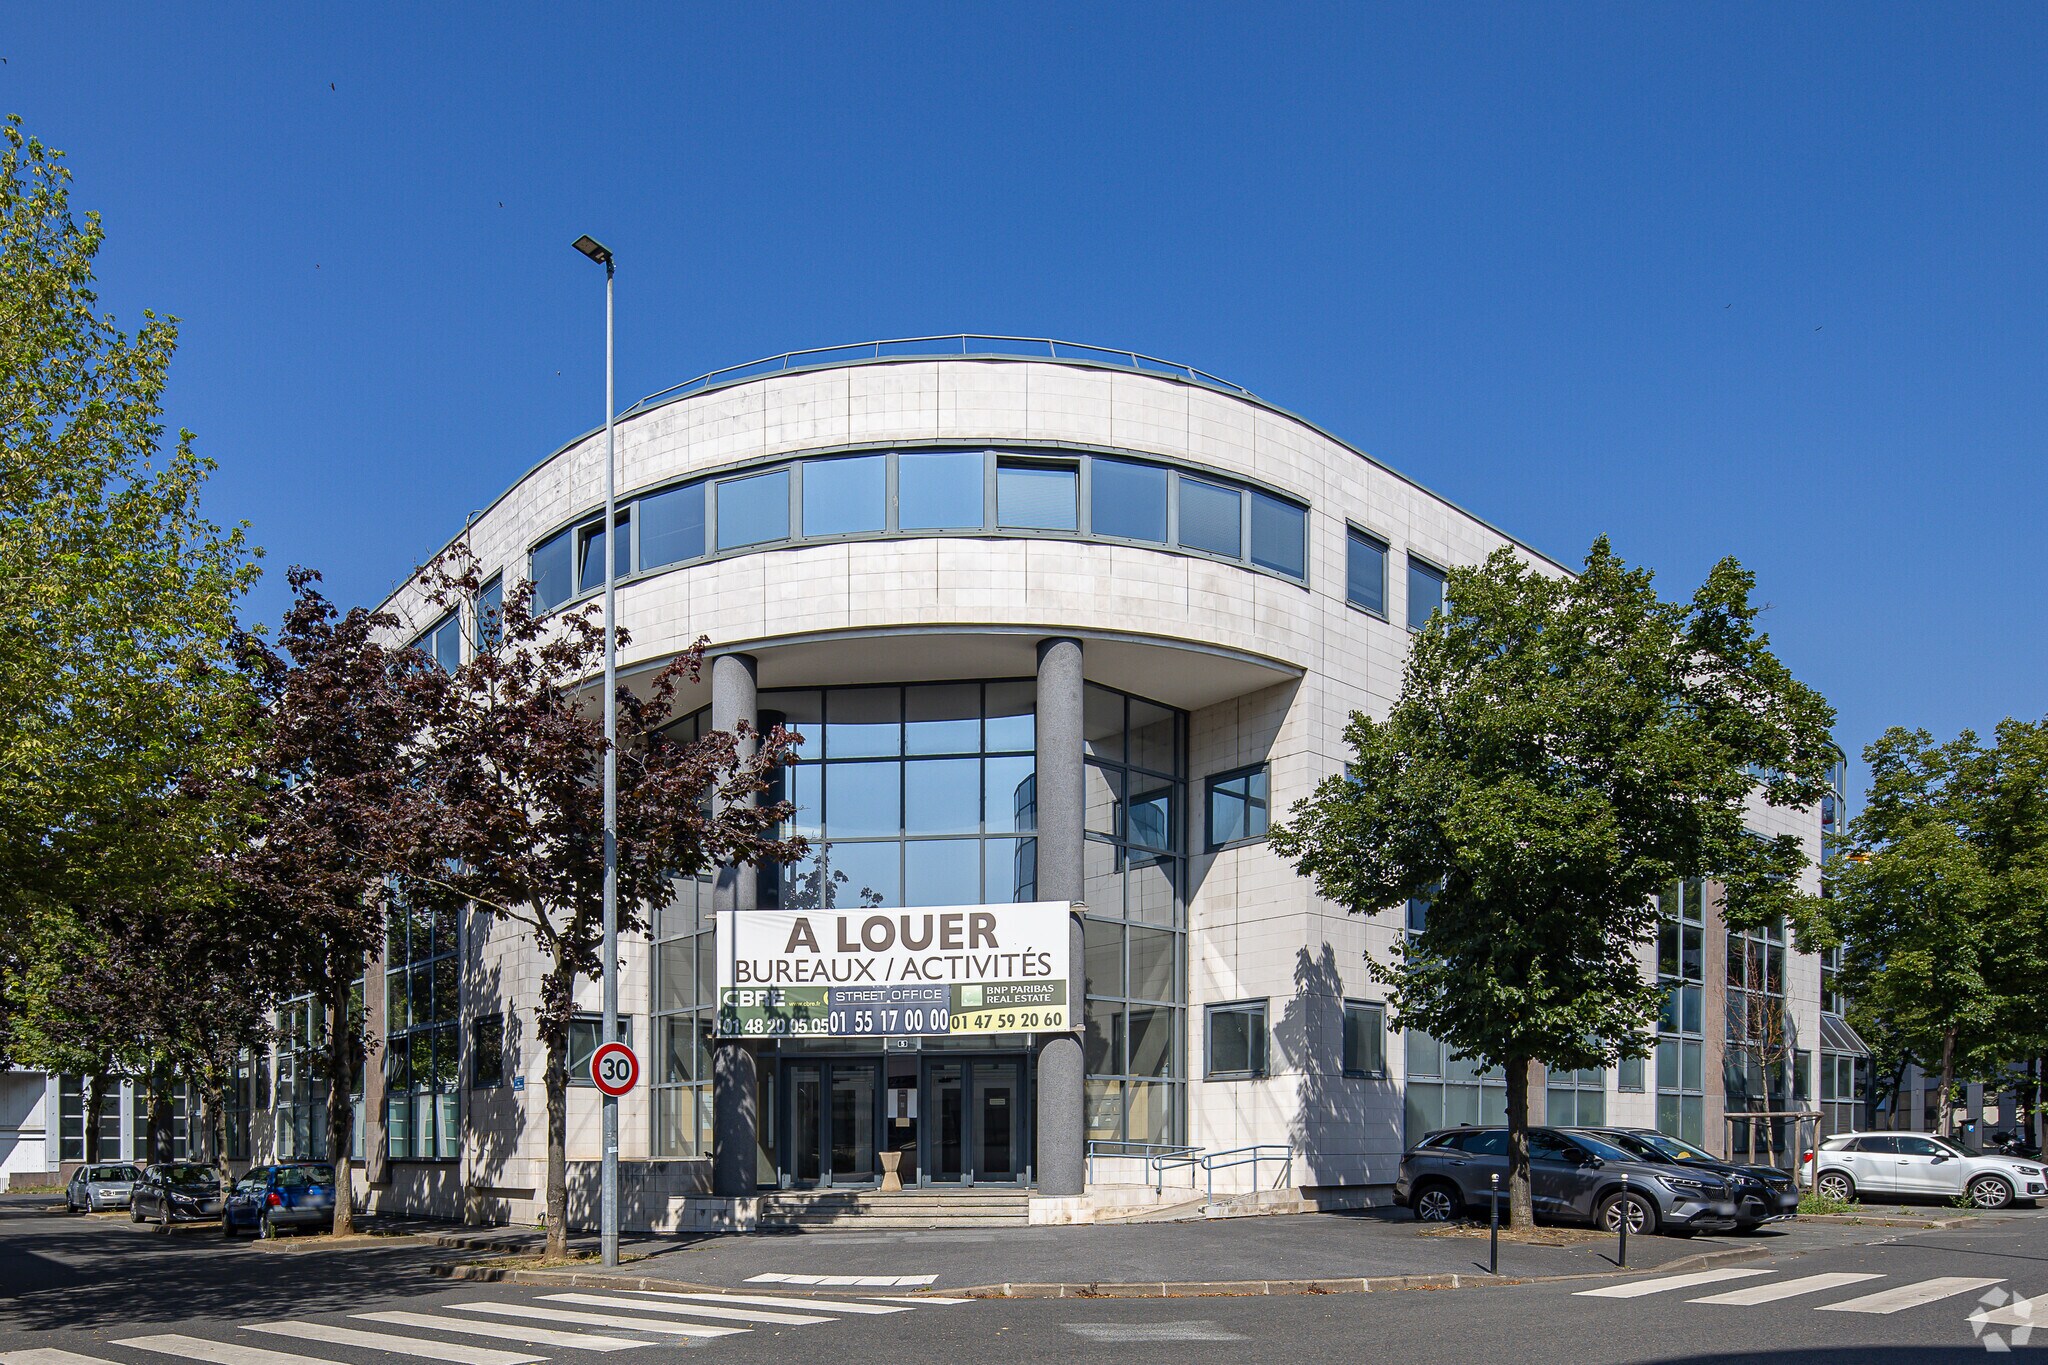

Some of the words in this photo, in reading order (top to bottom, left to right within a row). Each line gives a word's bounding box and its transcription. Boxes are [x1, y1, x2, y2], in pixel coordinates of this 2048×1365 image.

[784, 917, 821, 954] A
[837, 912, 1000, 953] LOUER
[735, 958, 876, 983] BUREAUX
[885, 957, 894, 981] /
[900, 946, 1052, 981] ACTIVITÉS
[835, 990, 886, 1002] STREET
[891, 989, 942, 1000] OFFICE
[986, 986, 1008, 995] BNP
[1010, 984, 1055, 994] PARIBAS
[723, 990, 786, 1007] CBRE
[986, 995, 1012, 1004] REAL
[1014, 993, 1052, 1003] ESTATE
[722, 1019, 740, 1034] 01
[744, 1018, 764, 1033] 48
[766, 1018, 785, 1033] 20
[789, 1018, 807, 1033] 05
[811, 1018, 829, 1033] 05
[829, 1011, 846, 1033] 01
[854, 1010, 873, 1032] 55
[880, 1009, 898, 1032] 17
[904, 1008, 924, 1032] 00
[930, 1008, 949, 1031] 00
[951, 1015, 967, 1030] 01
[974, 1014, 993, 1029] 47
[997, 1013, 1016, 1028] 59
[1020, 1013, 1039, 1027] 20
[1043, 1012, 1062, 1027] 60
[602, 1058, 630, 1081] 30
